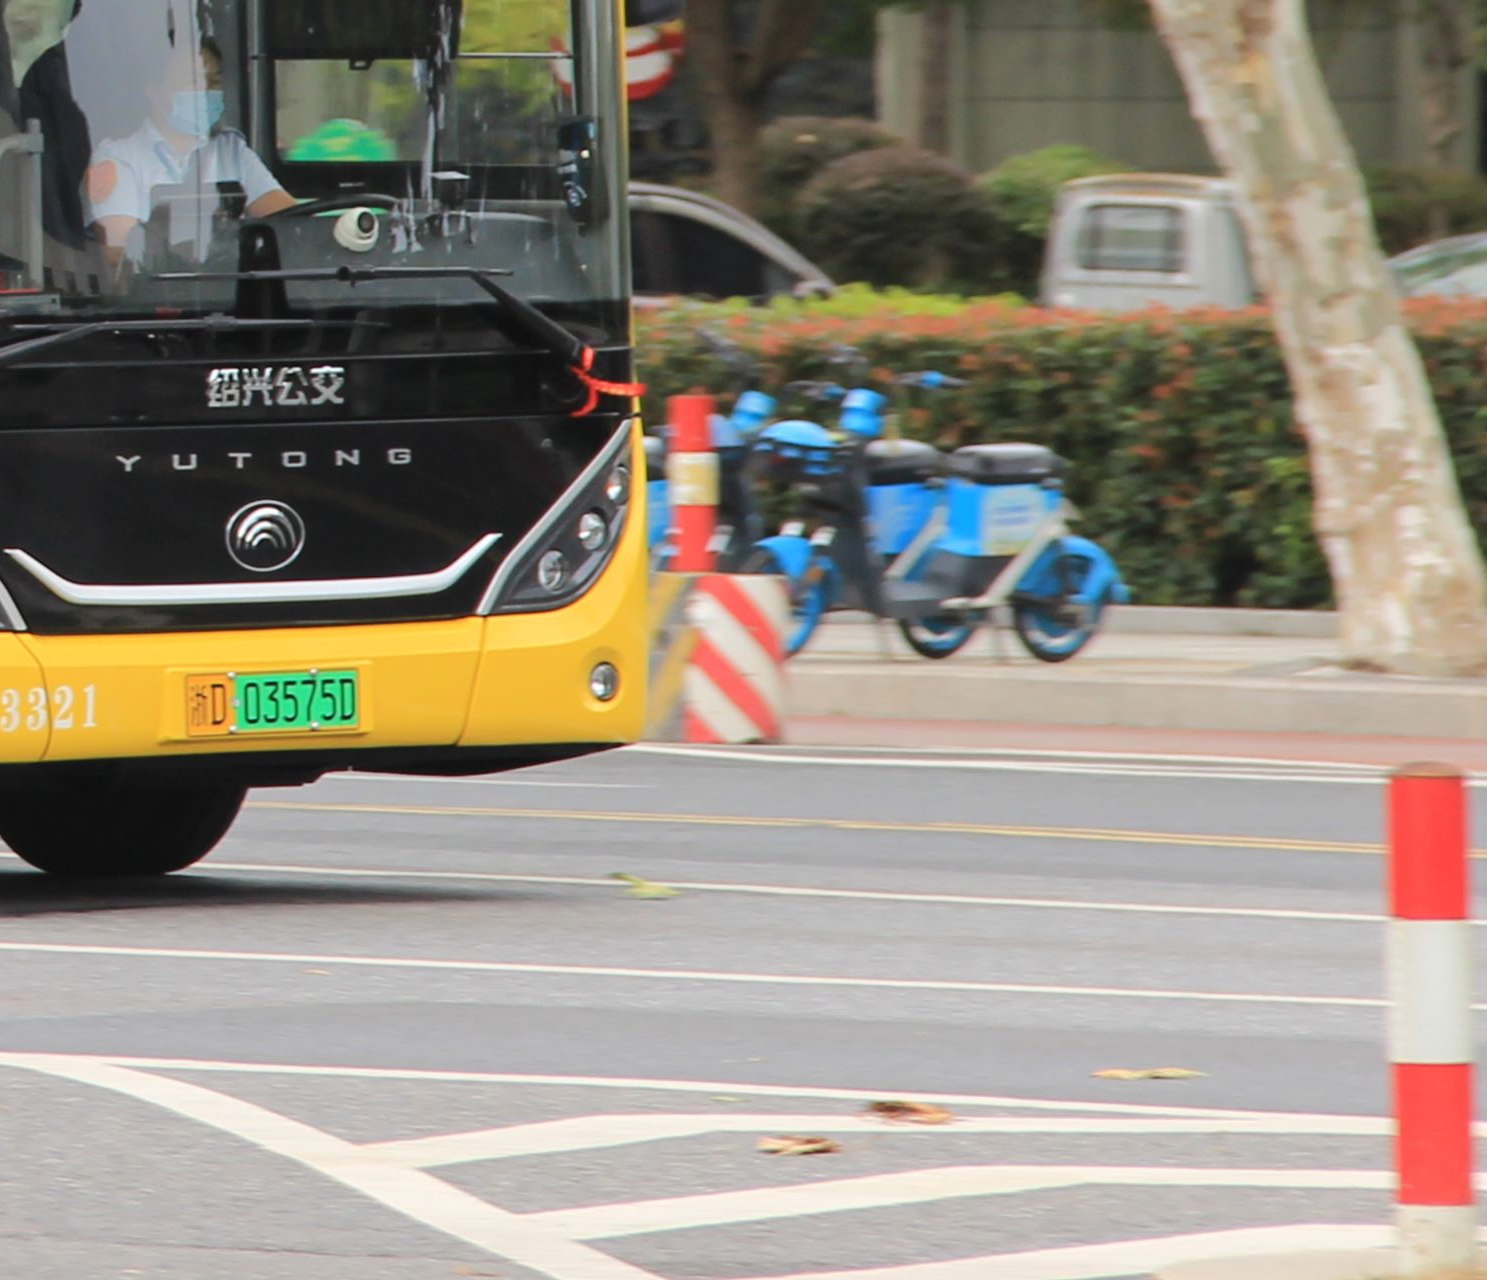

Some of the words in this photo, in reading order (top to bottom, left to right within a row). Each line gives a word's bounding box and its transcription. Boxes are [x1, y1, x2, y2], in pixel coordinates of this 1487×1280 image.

[206, 365, 345, 407] 绍兴公交
[115, 448, 412, 472] YUTONG
